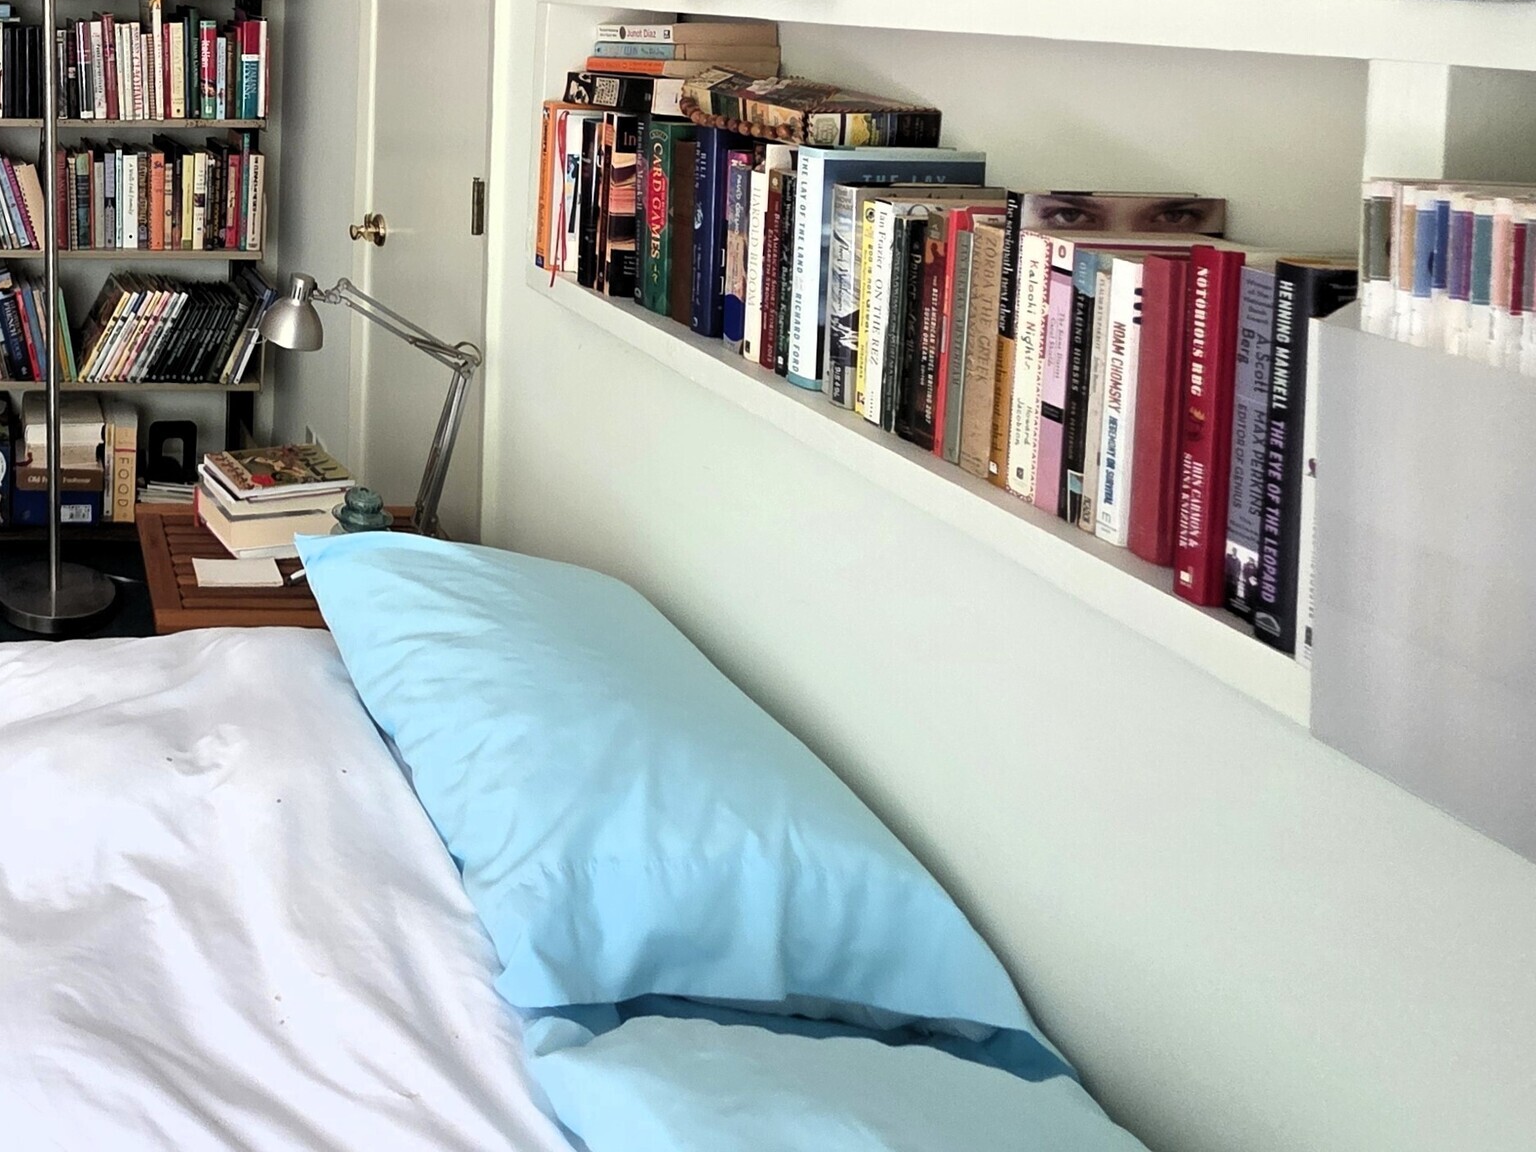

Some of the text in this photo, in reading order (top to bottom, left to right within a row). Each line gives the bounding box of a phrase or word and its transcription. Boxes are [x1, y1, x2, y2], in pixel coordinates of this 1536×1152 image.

[243, 63, 251, 99] COOKING
[635, 122, 645, 211] Henning Mankell
[650, 143, 664, 259] CARD GAMES
[747, 188, 761, 306] HAROLD BLOOM
[769, 236, 779, 307] AMERICAN SHORT
[791, 157, 809, 373] THE LAY OF THE LAND RICHARD FORD
[869, 211, 887, 366] Ian Frazier ON THE REZ
[998, 198, 1018, 332] the sociopath next door
[4, 302, 16, 336] FRENCH
[927, 345, 935, 371] TRAVEL
[976, 237, 997, 383] ZORBA THE GREEK
[1020, 260, 1039, 370] Kalooki Nights
[1070, 289, 1085, 392] STEALING HORSES
[1190, 266, 1209, 397] NOTORIOUS RBG
[1236, 327, 1255, 364] Berg
[1014, 398, 1025, 445] Jacobson
[1023, 405, 1033, 445] Howard
[1103, 322, 1126, 505] NOAM CHOMSKY HEGEMONY OR SURVIVAL
[1231, 403, 1248, 509] EDITOR OF GENIUS
[1248, 409, 1268, 517] MAX PERKINS
[1261, 280, 1294, 603] HENNING MANKELL THE EYE OF THE LEOPARD
[117, 456, 130, 508] FOOD
